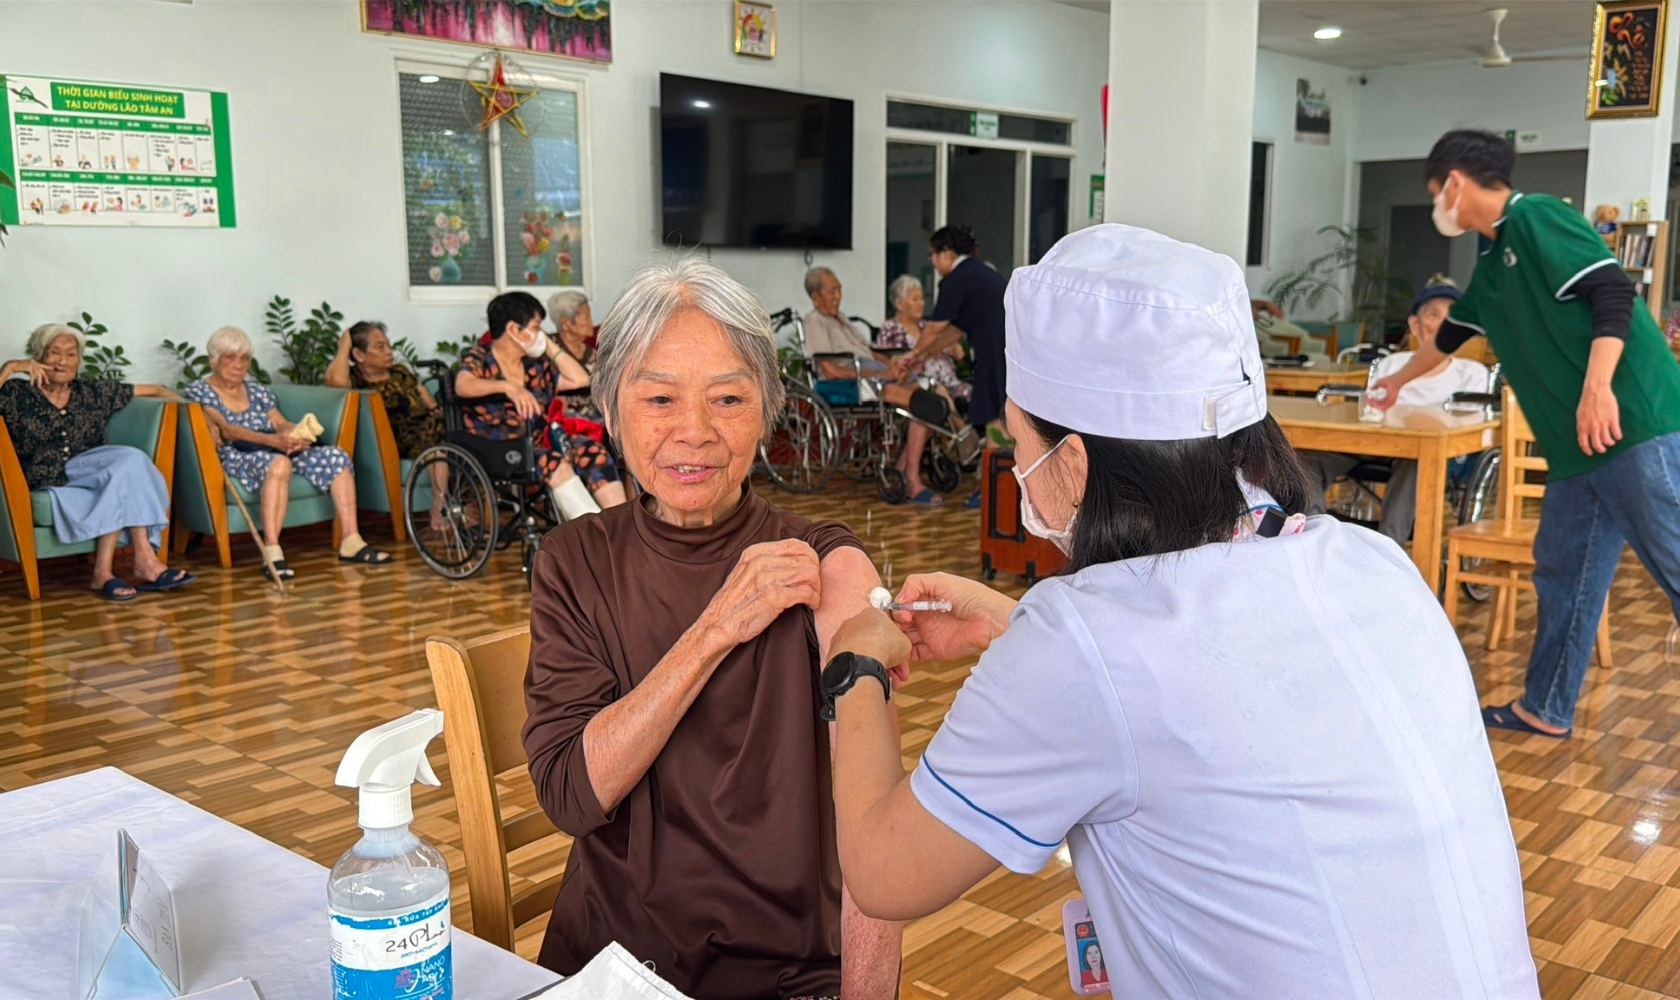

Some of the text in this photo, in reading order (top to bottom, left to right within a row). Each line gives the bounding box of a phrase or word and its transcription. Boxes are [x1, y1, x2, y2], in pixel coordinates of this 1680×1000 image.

[83, 88, 107, 98] GIAN
[131, 92, 153, 102] SINH
[160, 106, 174, 115] AN
[421, 908, 433, 917] TAY
